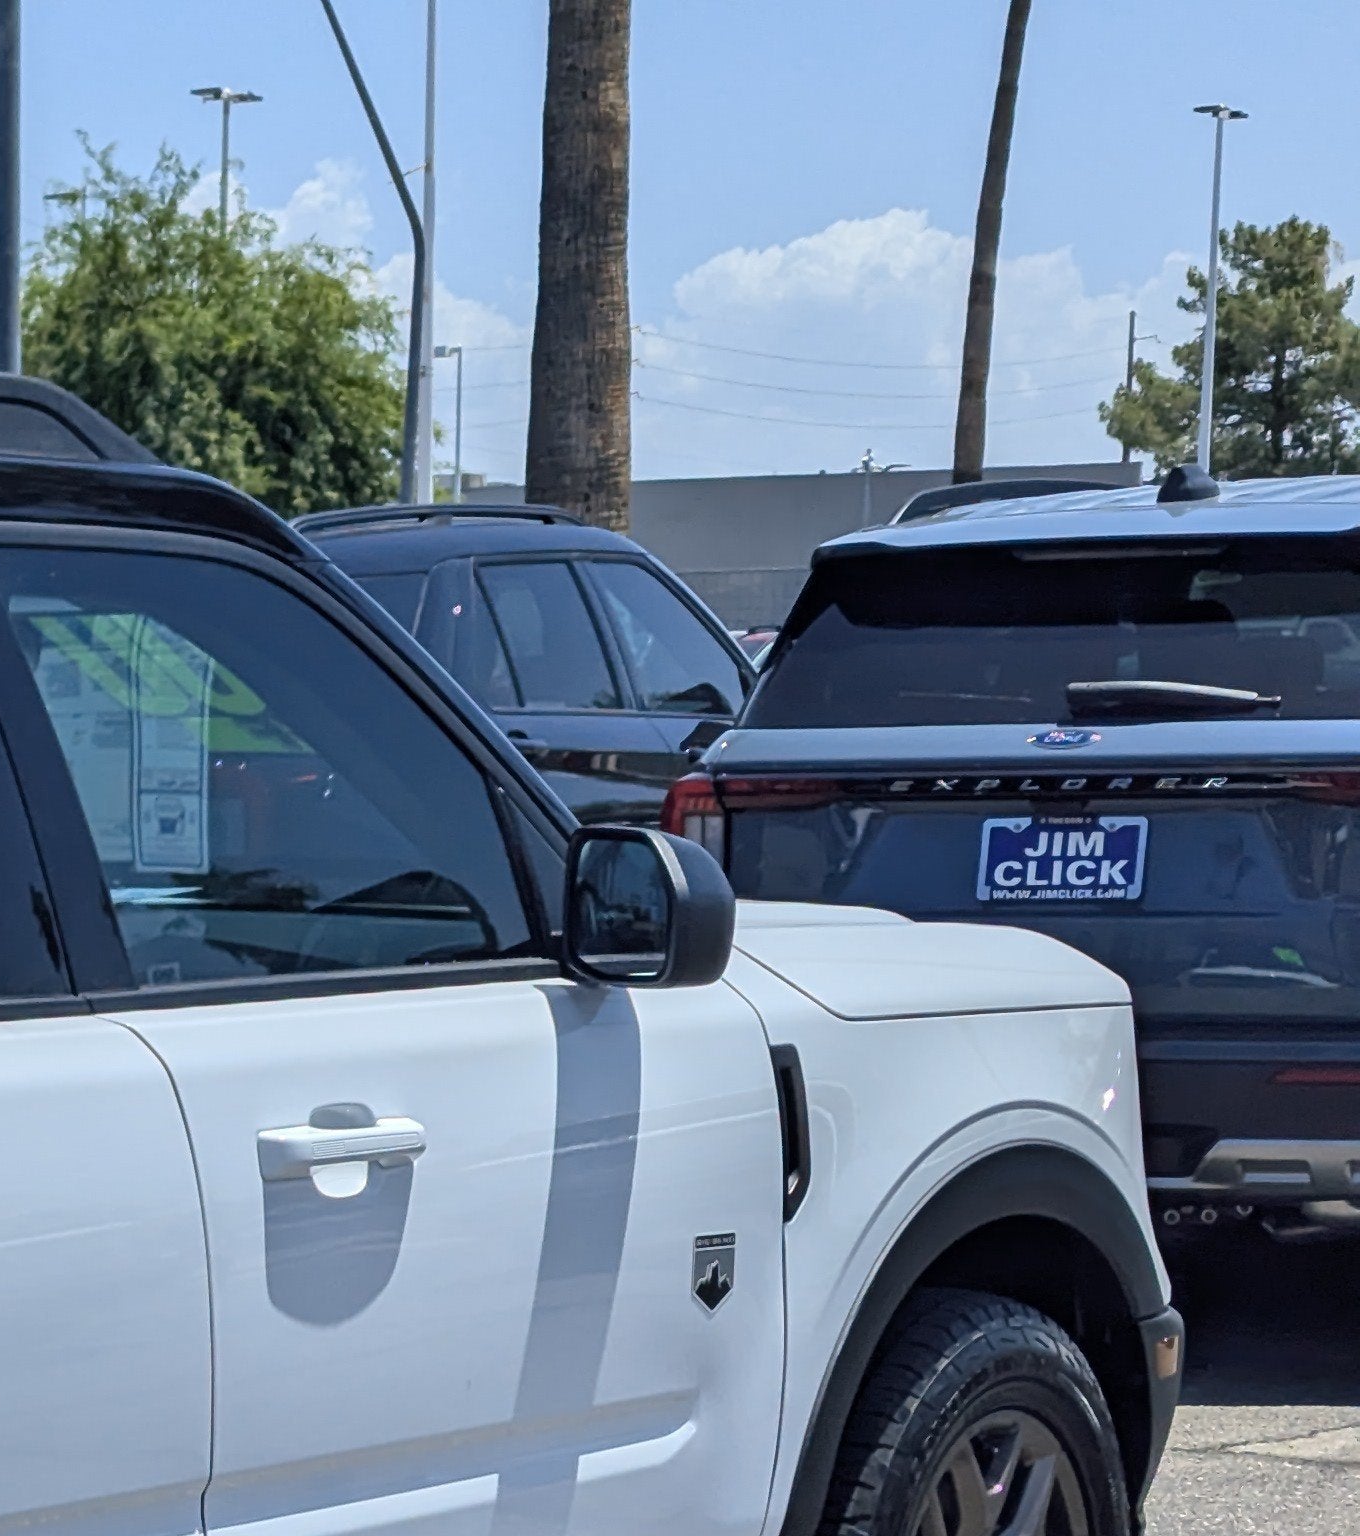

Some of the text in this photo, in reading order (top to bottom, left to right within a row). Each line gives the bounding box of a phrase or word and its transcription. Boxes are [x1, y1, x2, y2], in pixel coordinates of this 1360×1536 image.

[889, 776, 1229, 793] EXPLORER
[1024, 831, 1105, 857] JIM
[993, 859, 1130, 887] CLICK
[992, 888, 1126, 900] WWW.JIMCLICK.COM
